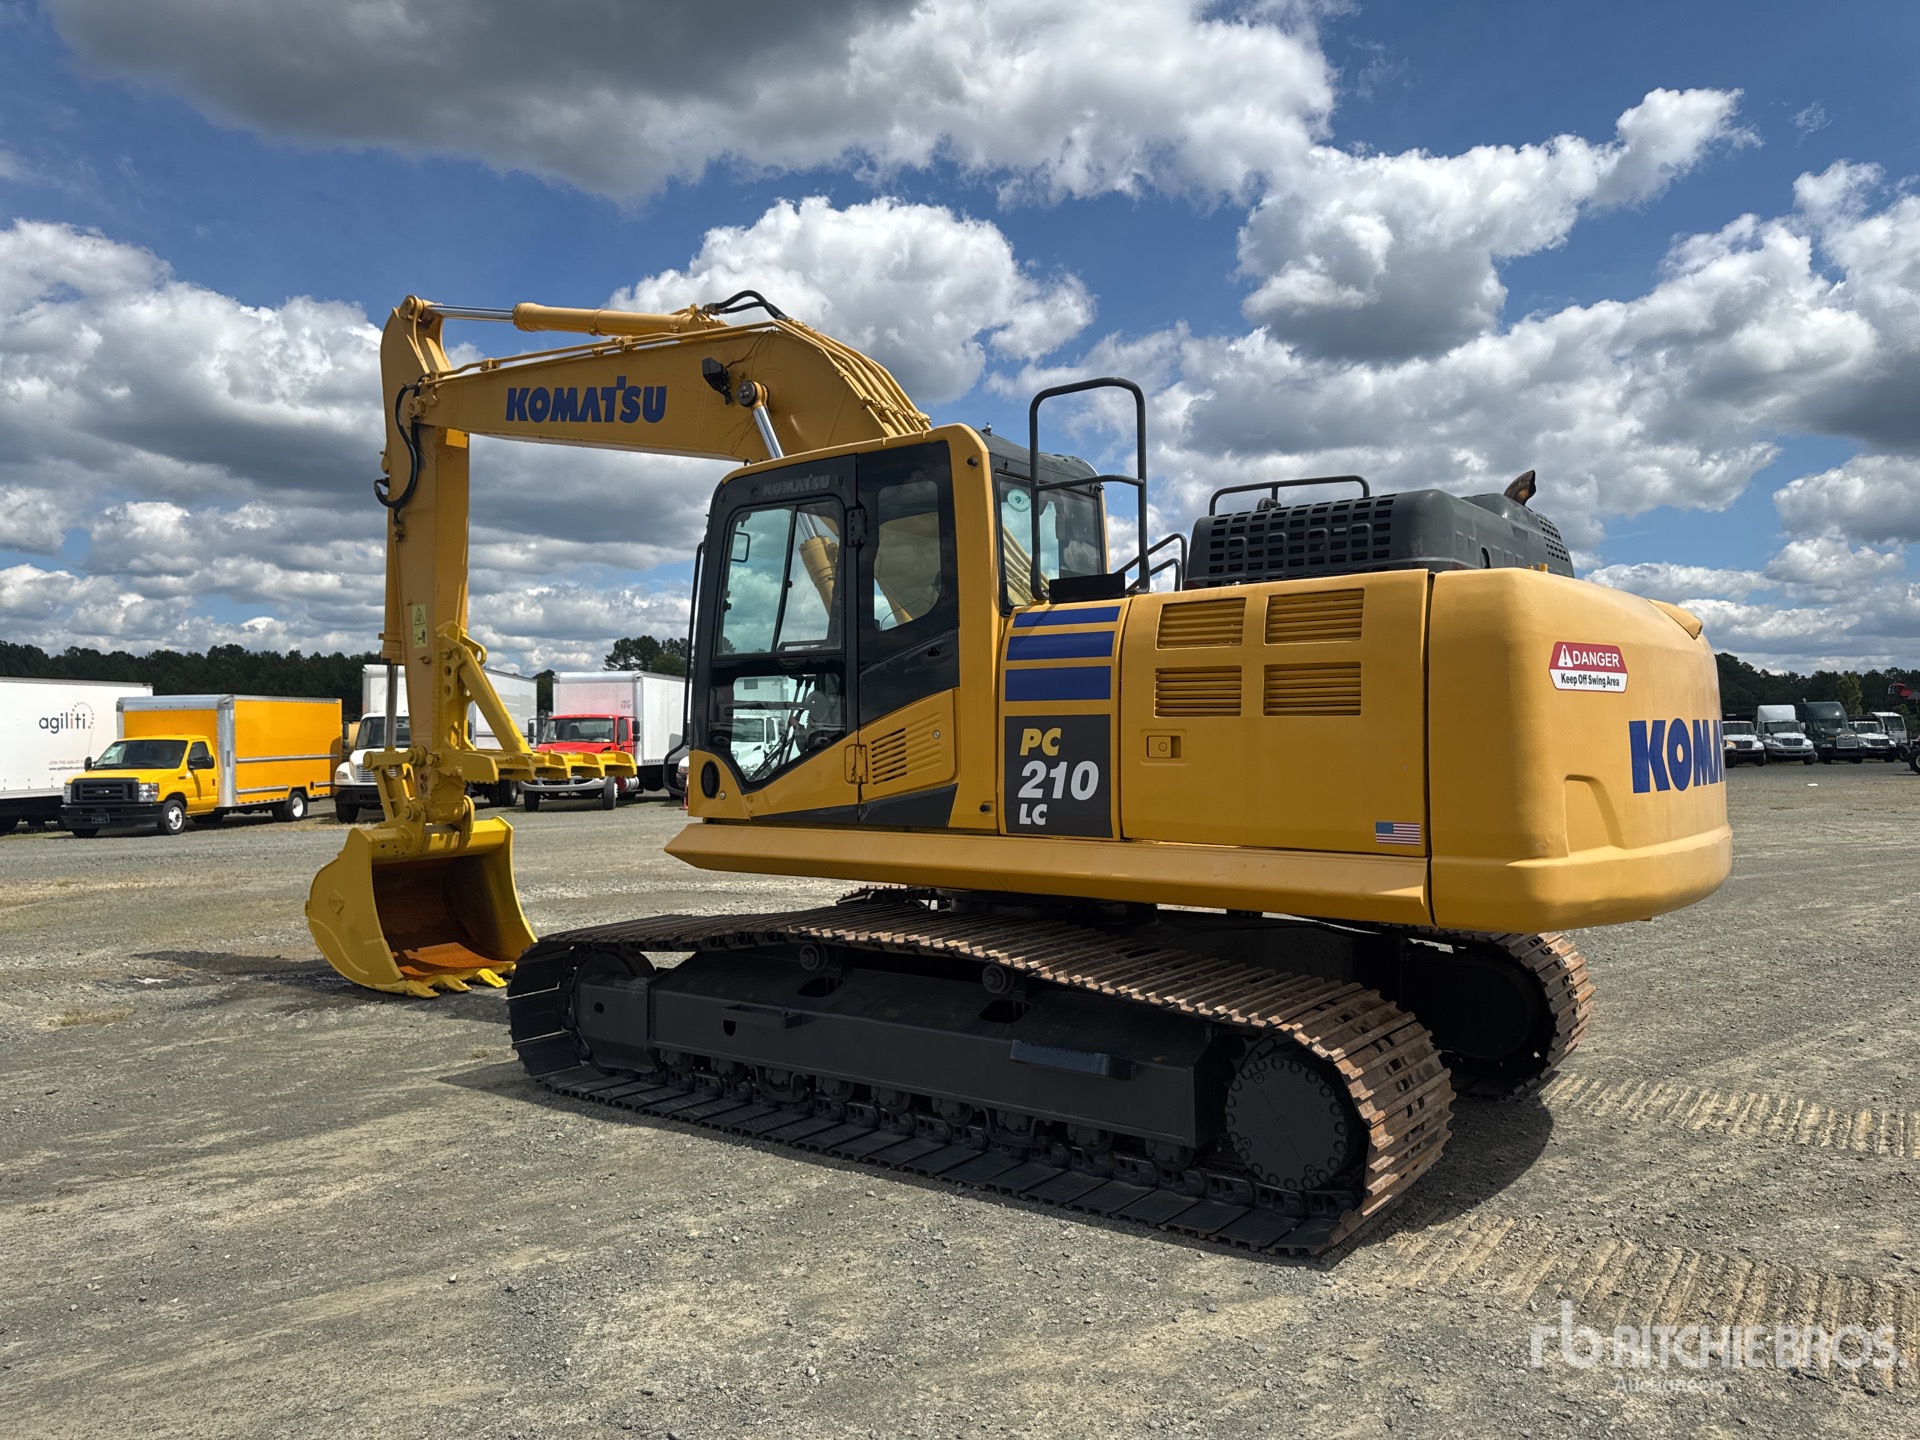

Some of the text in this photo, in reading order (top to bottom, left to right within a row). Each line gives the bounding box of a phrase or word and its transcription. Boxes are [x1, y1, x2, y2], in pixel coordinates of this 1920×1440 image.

[506, 376, 667, 424] KOMATSU
[763, 474, 830, 496] KOMATSU
[1572, 650, 1620, 667] DANGER
[1561, 673, 1620, 688] Keep Off Swing Area
[39, 712, 85, 734] agiliti
[1020, 728, 1062, 756] PC
[1018, 760, 1099, 800] 210
[1019, 804, 1048, 825] LC
